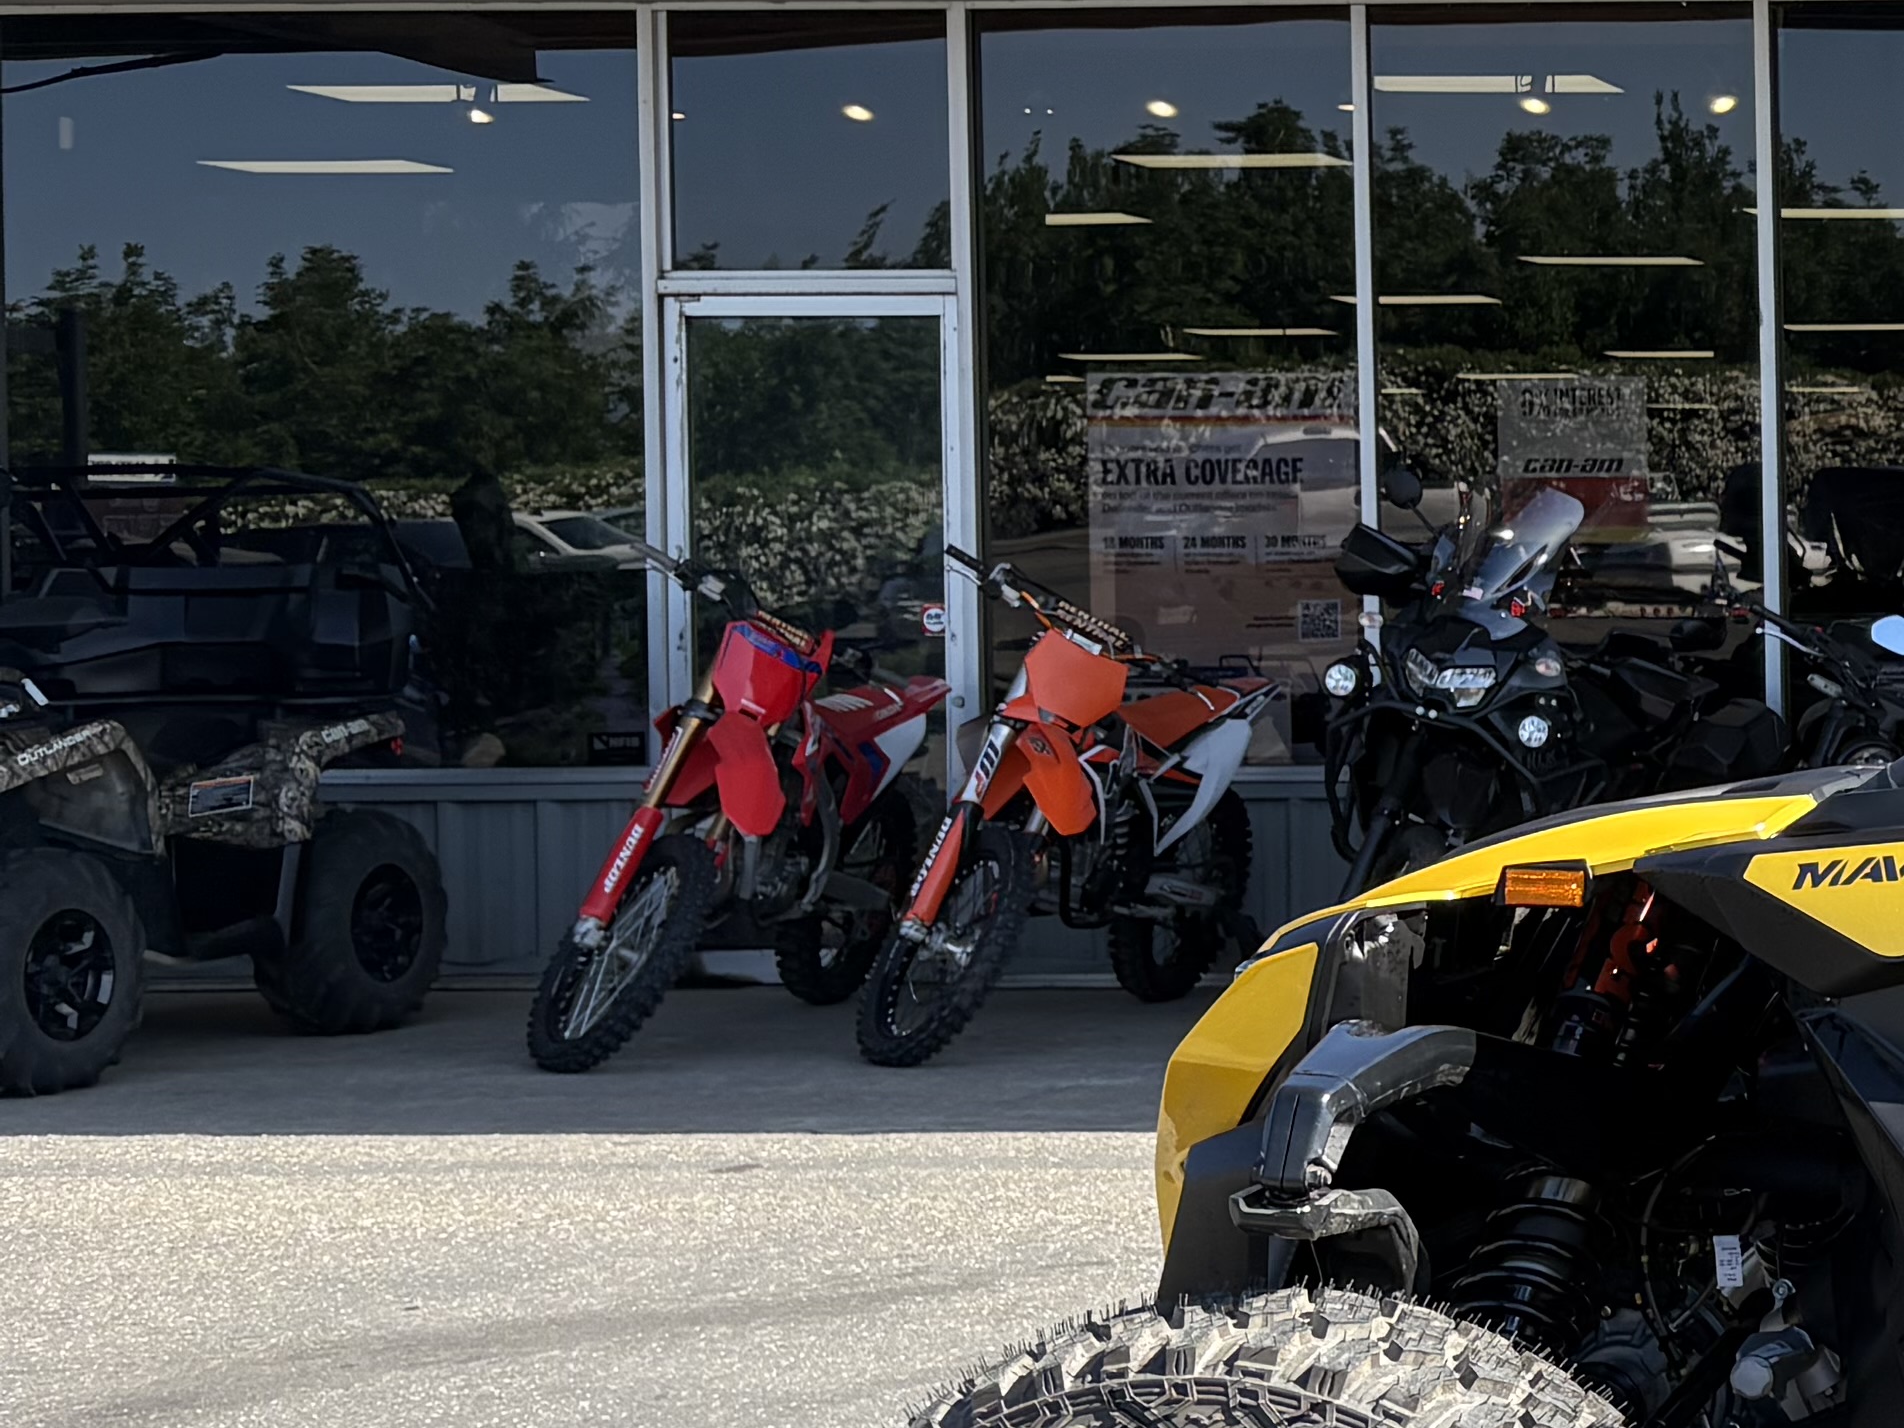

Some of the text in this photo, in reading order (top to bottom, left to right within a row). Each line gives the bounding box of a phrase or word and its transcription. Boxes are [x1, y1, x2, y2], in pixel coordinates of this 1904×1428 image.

[1101, 458, 1177, 486] EXTRA
[1521, 458, 1624, 474] can-am
[1118, 535, 1164, 549] MONTHS
[1201, 535, 1247, 549] MONTHS
[321, 718, 371, 744] can-am
[604, 823, 645, 894] DUNLOP
